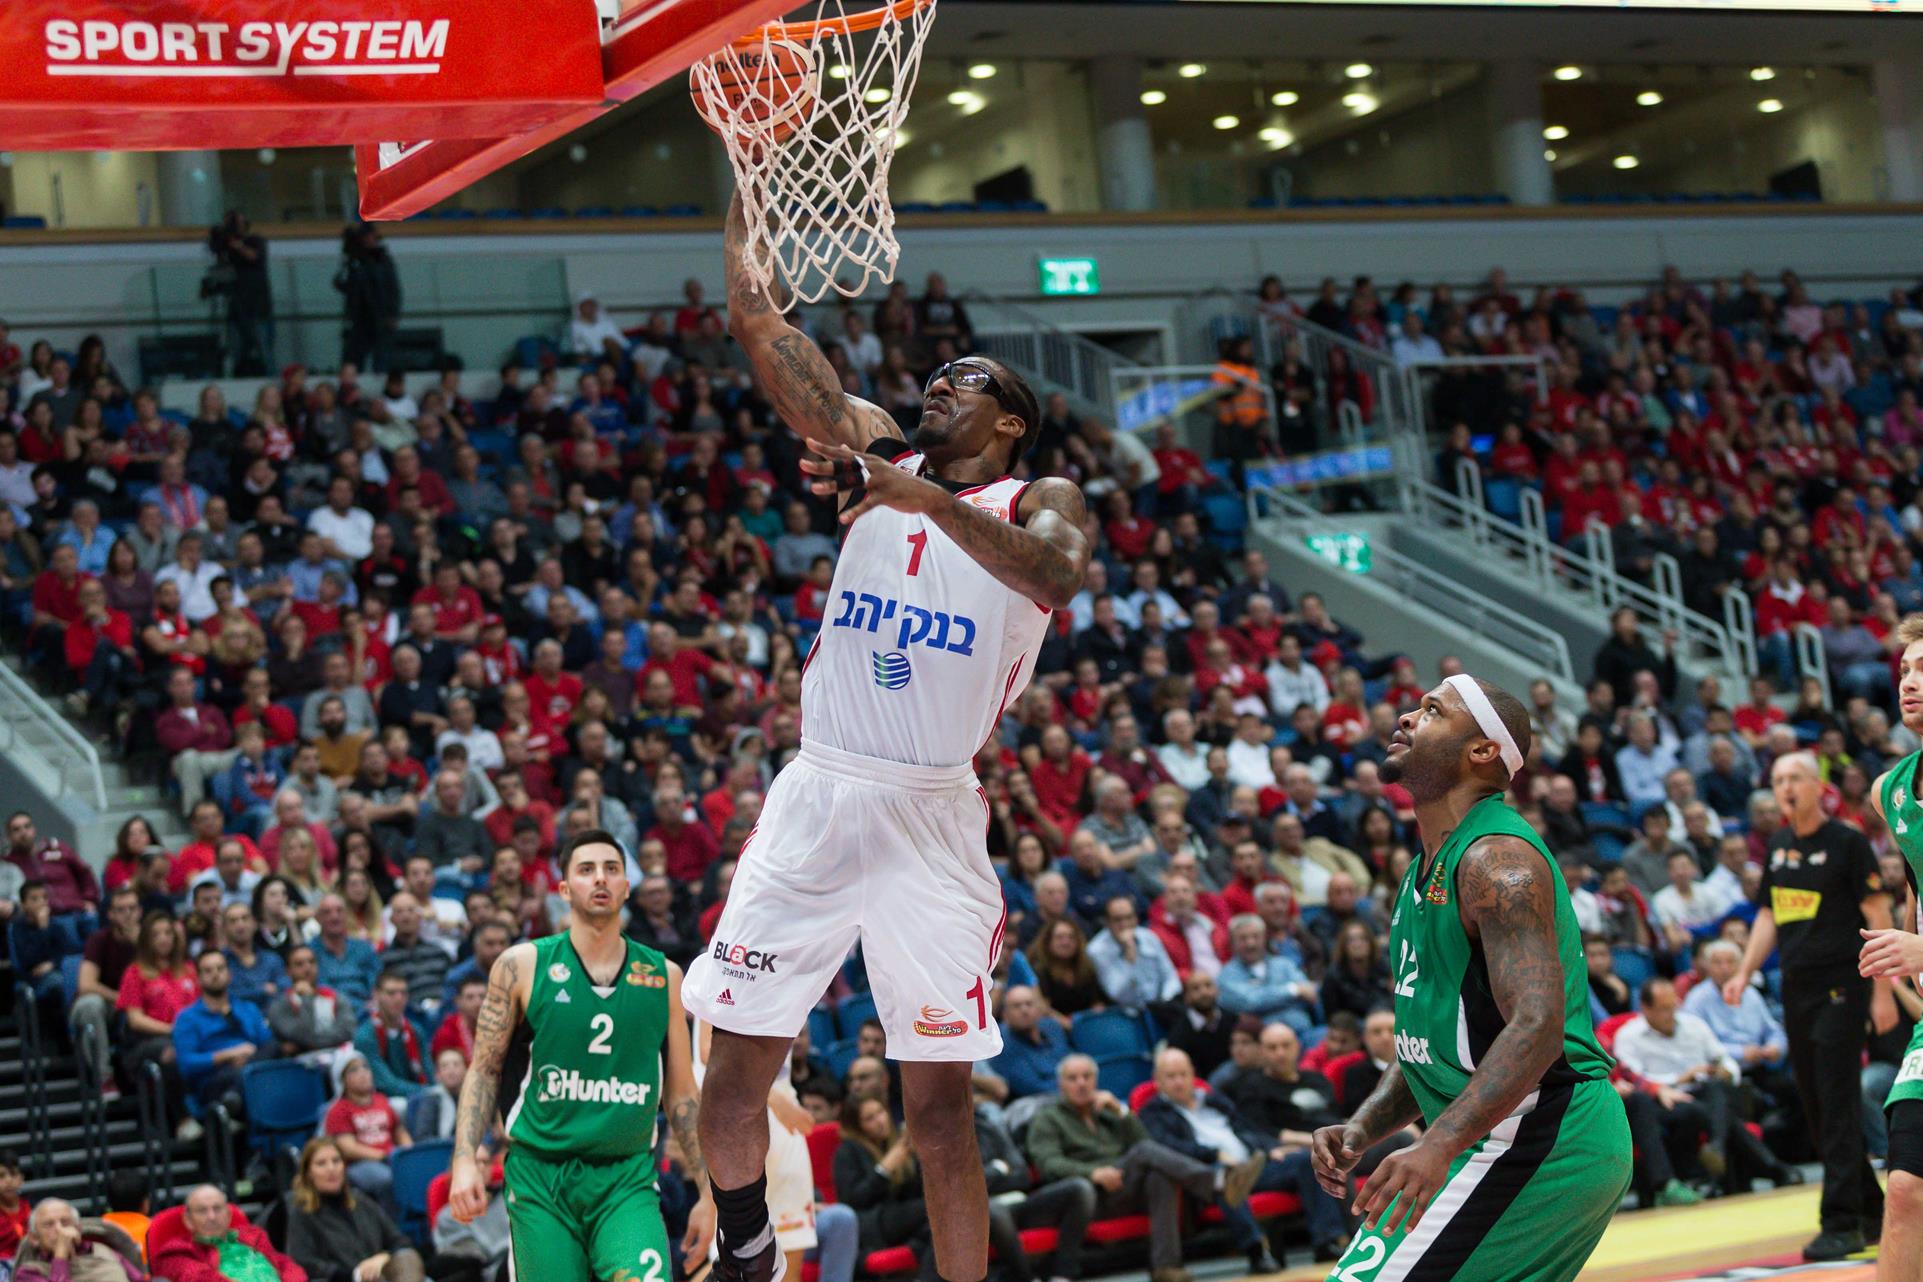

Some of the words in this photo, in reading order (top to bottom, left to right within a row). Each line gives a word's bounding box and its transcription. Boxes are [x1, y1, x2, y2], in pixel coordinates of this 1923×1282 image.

[44, 19, 229, 62] SPORT
[235, 19, 450, 76] SYSTEM
[906, 528, 928, 577] 1
[833, 590, 898, 633] יהב
[897, 604, 976, 657] בנק
[966, 975, 987, 1031] 1
[587, 1013, 614, 1055] 2
[560, 1069, 651, 1105] Hunter
[639, 1247, 665, 1282] 2
